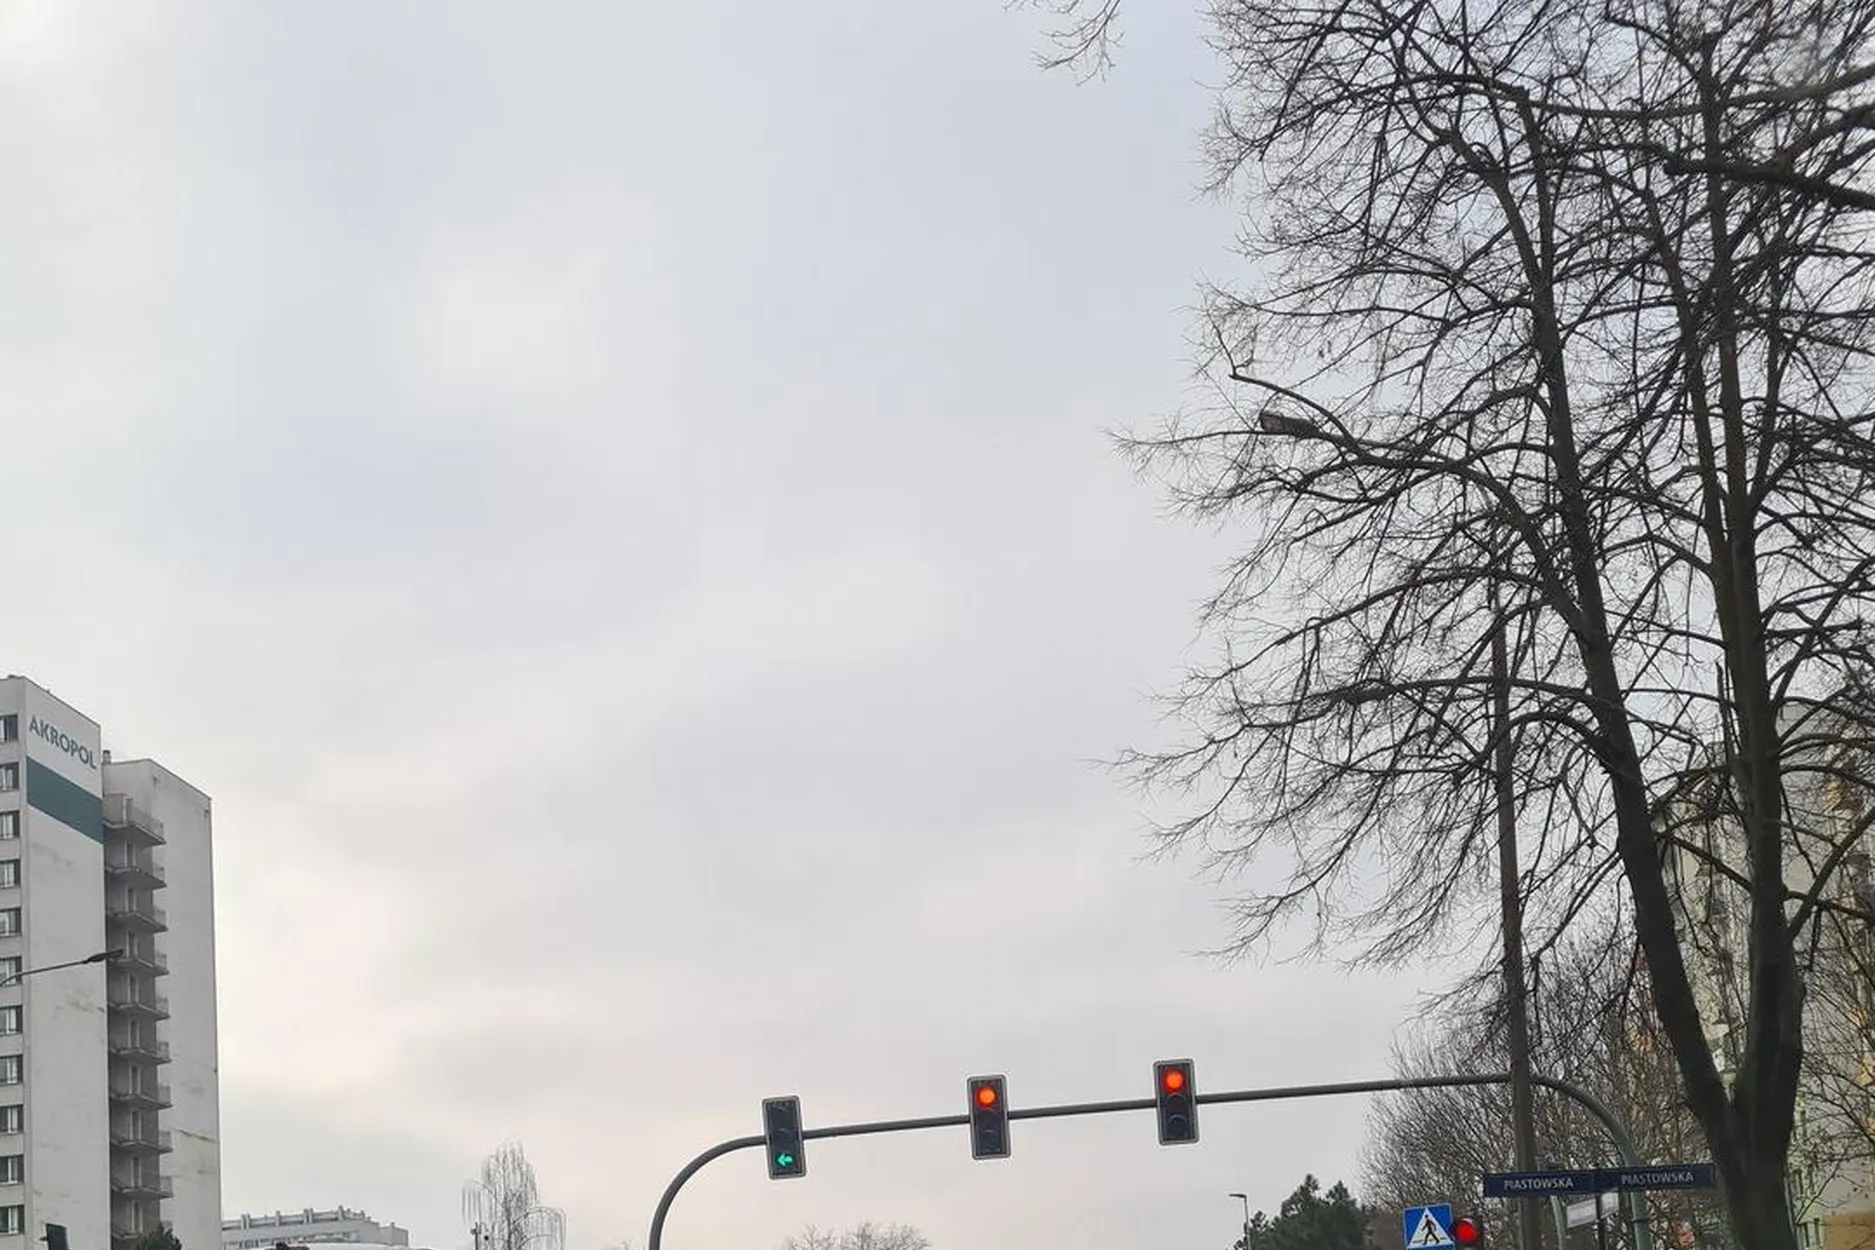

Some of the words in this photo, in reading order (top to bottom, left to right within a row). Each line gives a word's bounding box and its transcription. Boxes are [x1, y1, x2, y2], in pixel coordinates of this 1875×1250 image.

[29, 713, 97, 770] AKROPOL
[1503, 1177, 1574, 1191] PIASTOWSKA
[1620, 1171, 1694, 1186] PIASTOWSKA
